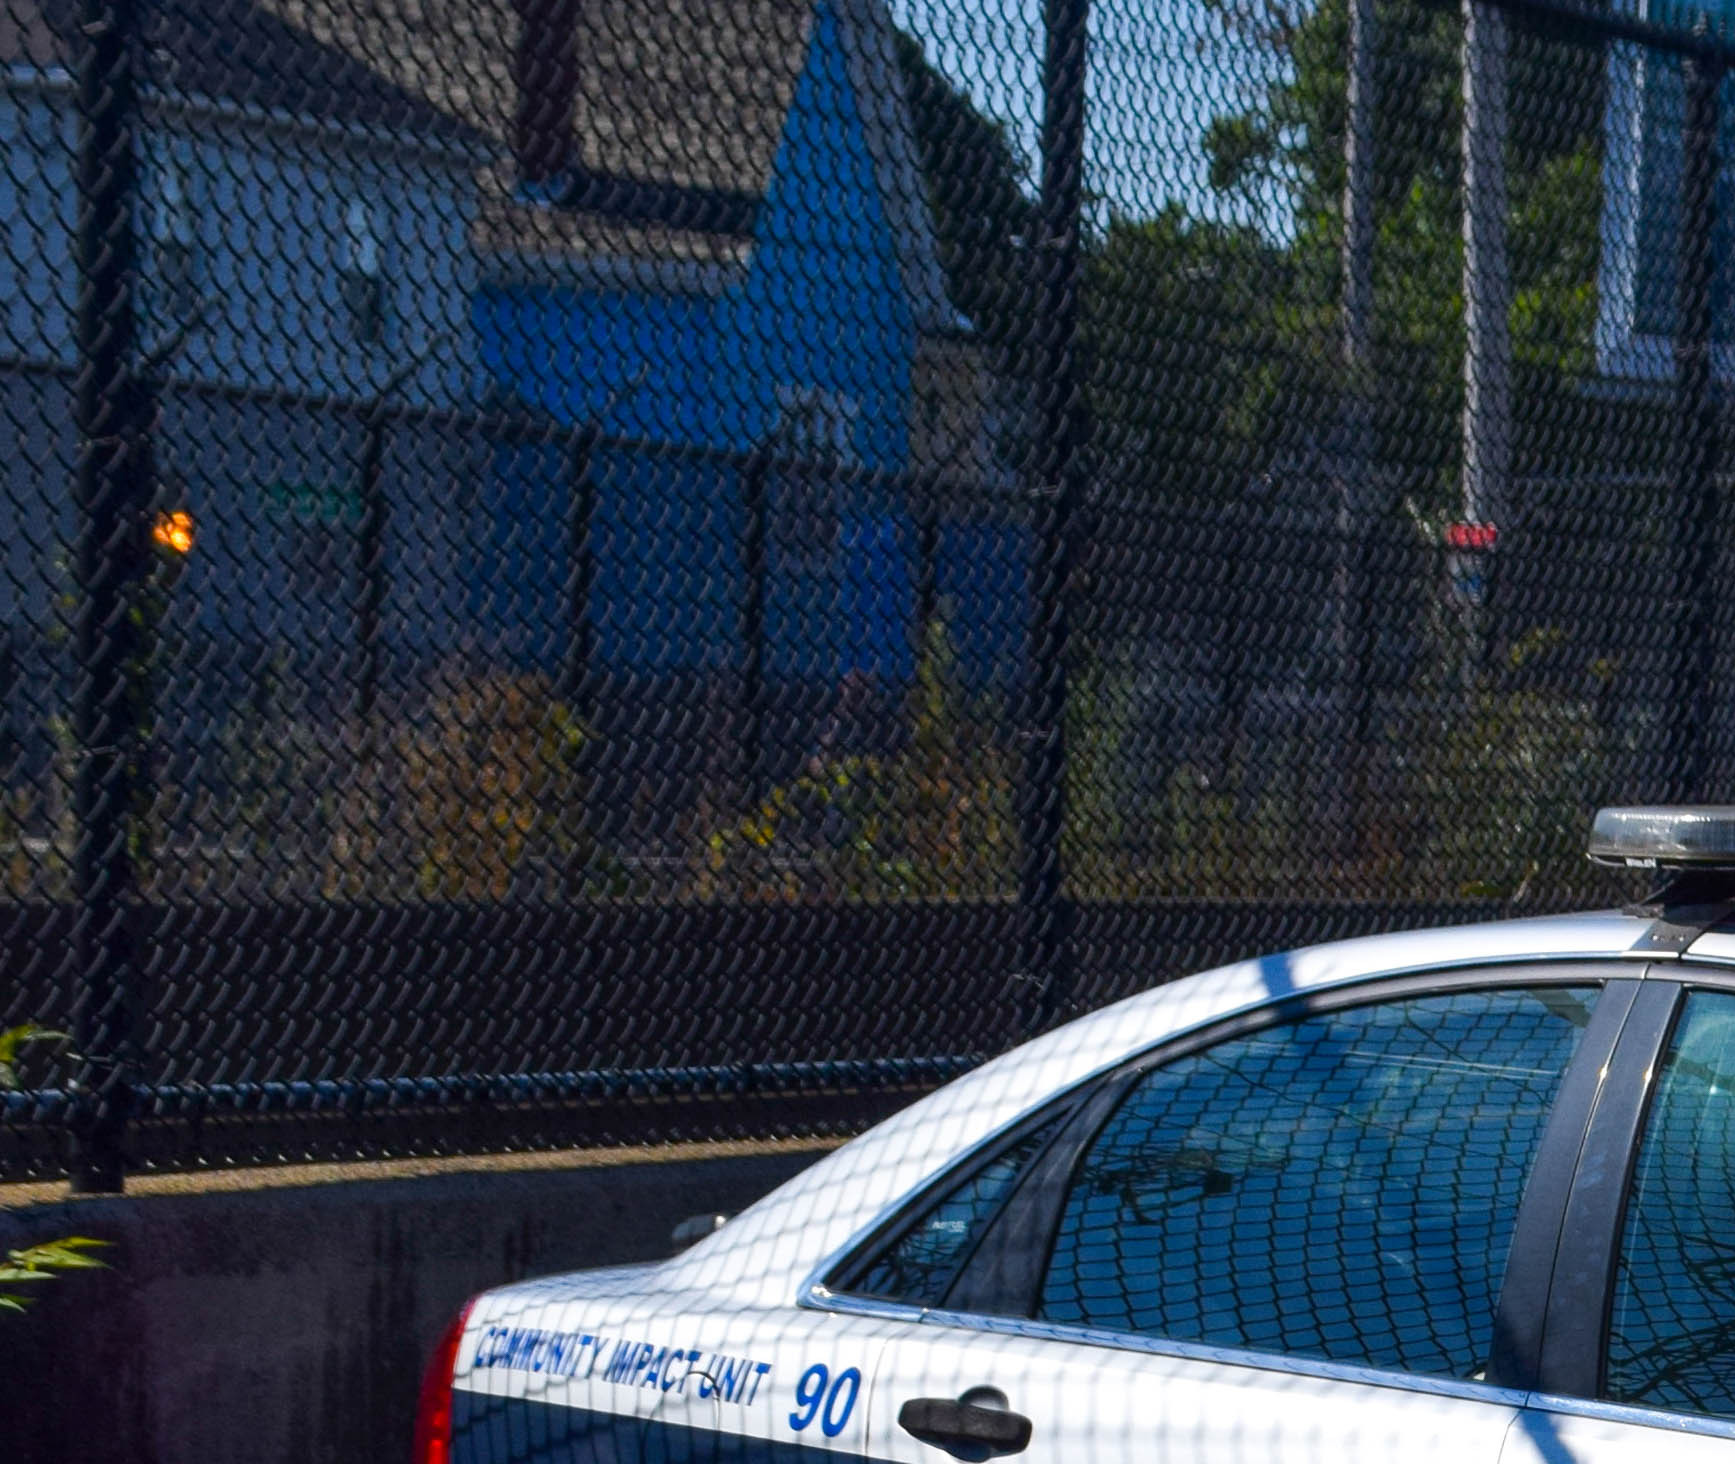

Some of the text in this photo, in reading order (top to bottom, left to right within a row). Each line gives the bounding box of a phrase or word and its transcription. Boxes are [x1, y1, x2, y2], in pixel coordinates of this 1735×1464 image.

[473, 1326, 774, 1407] COMMUNITY IMPACT UNIT
[788, 1363, 862, 1438] 90
